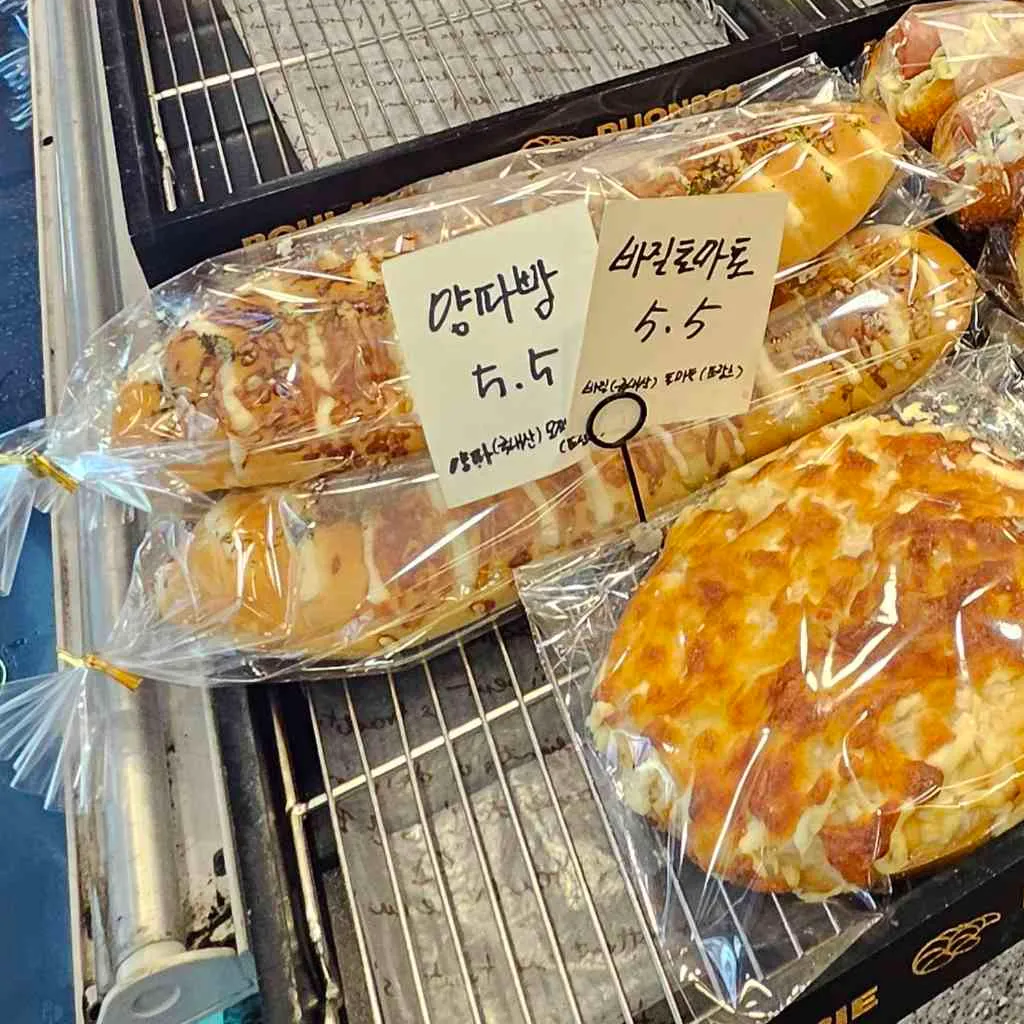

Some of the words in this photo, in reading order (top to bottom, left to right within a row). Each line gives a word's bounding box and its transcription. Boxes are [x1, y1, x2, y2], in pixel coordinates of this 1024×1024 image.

[608, 235, 755, 281] 바질토마토
[634, 296, 723, 344] 5.5
[471, 348, 560, 399] 5.5
